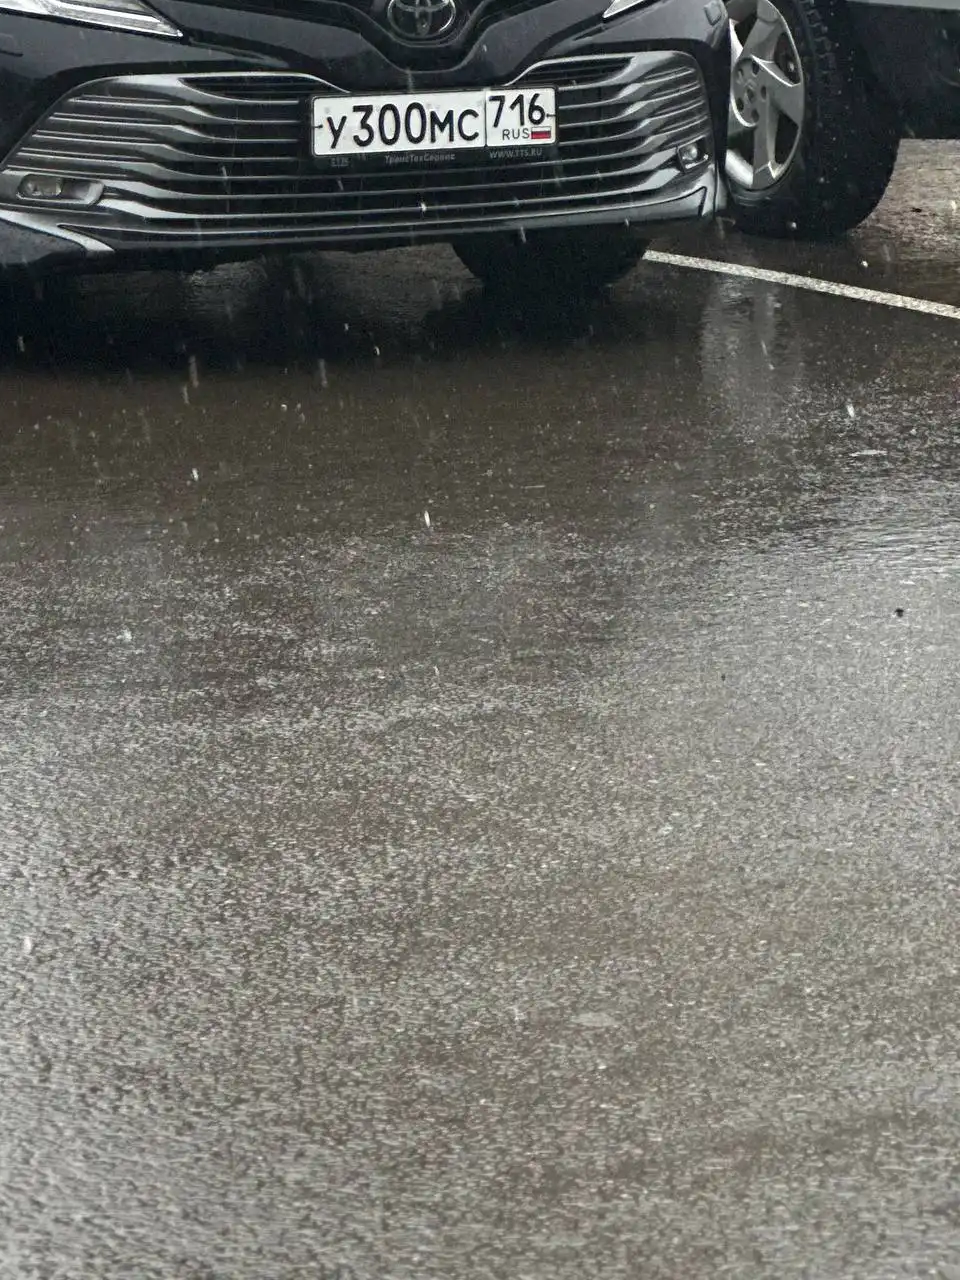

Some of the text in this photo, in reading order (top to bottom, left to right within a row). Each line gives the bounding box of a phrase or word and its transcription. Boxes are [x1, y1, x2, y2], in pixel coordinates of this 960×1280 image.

[326, 92, 547, 149] У300МС 716
[502, 127, 531, 140] RUS
